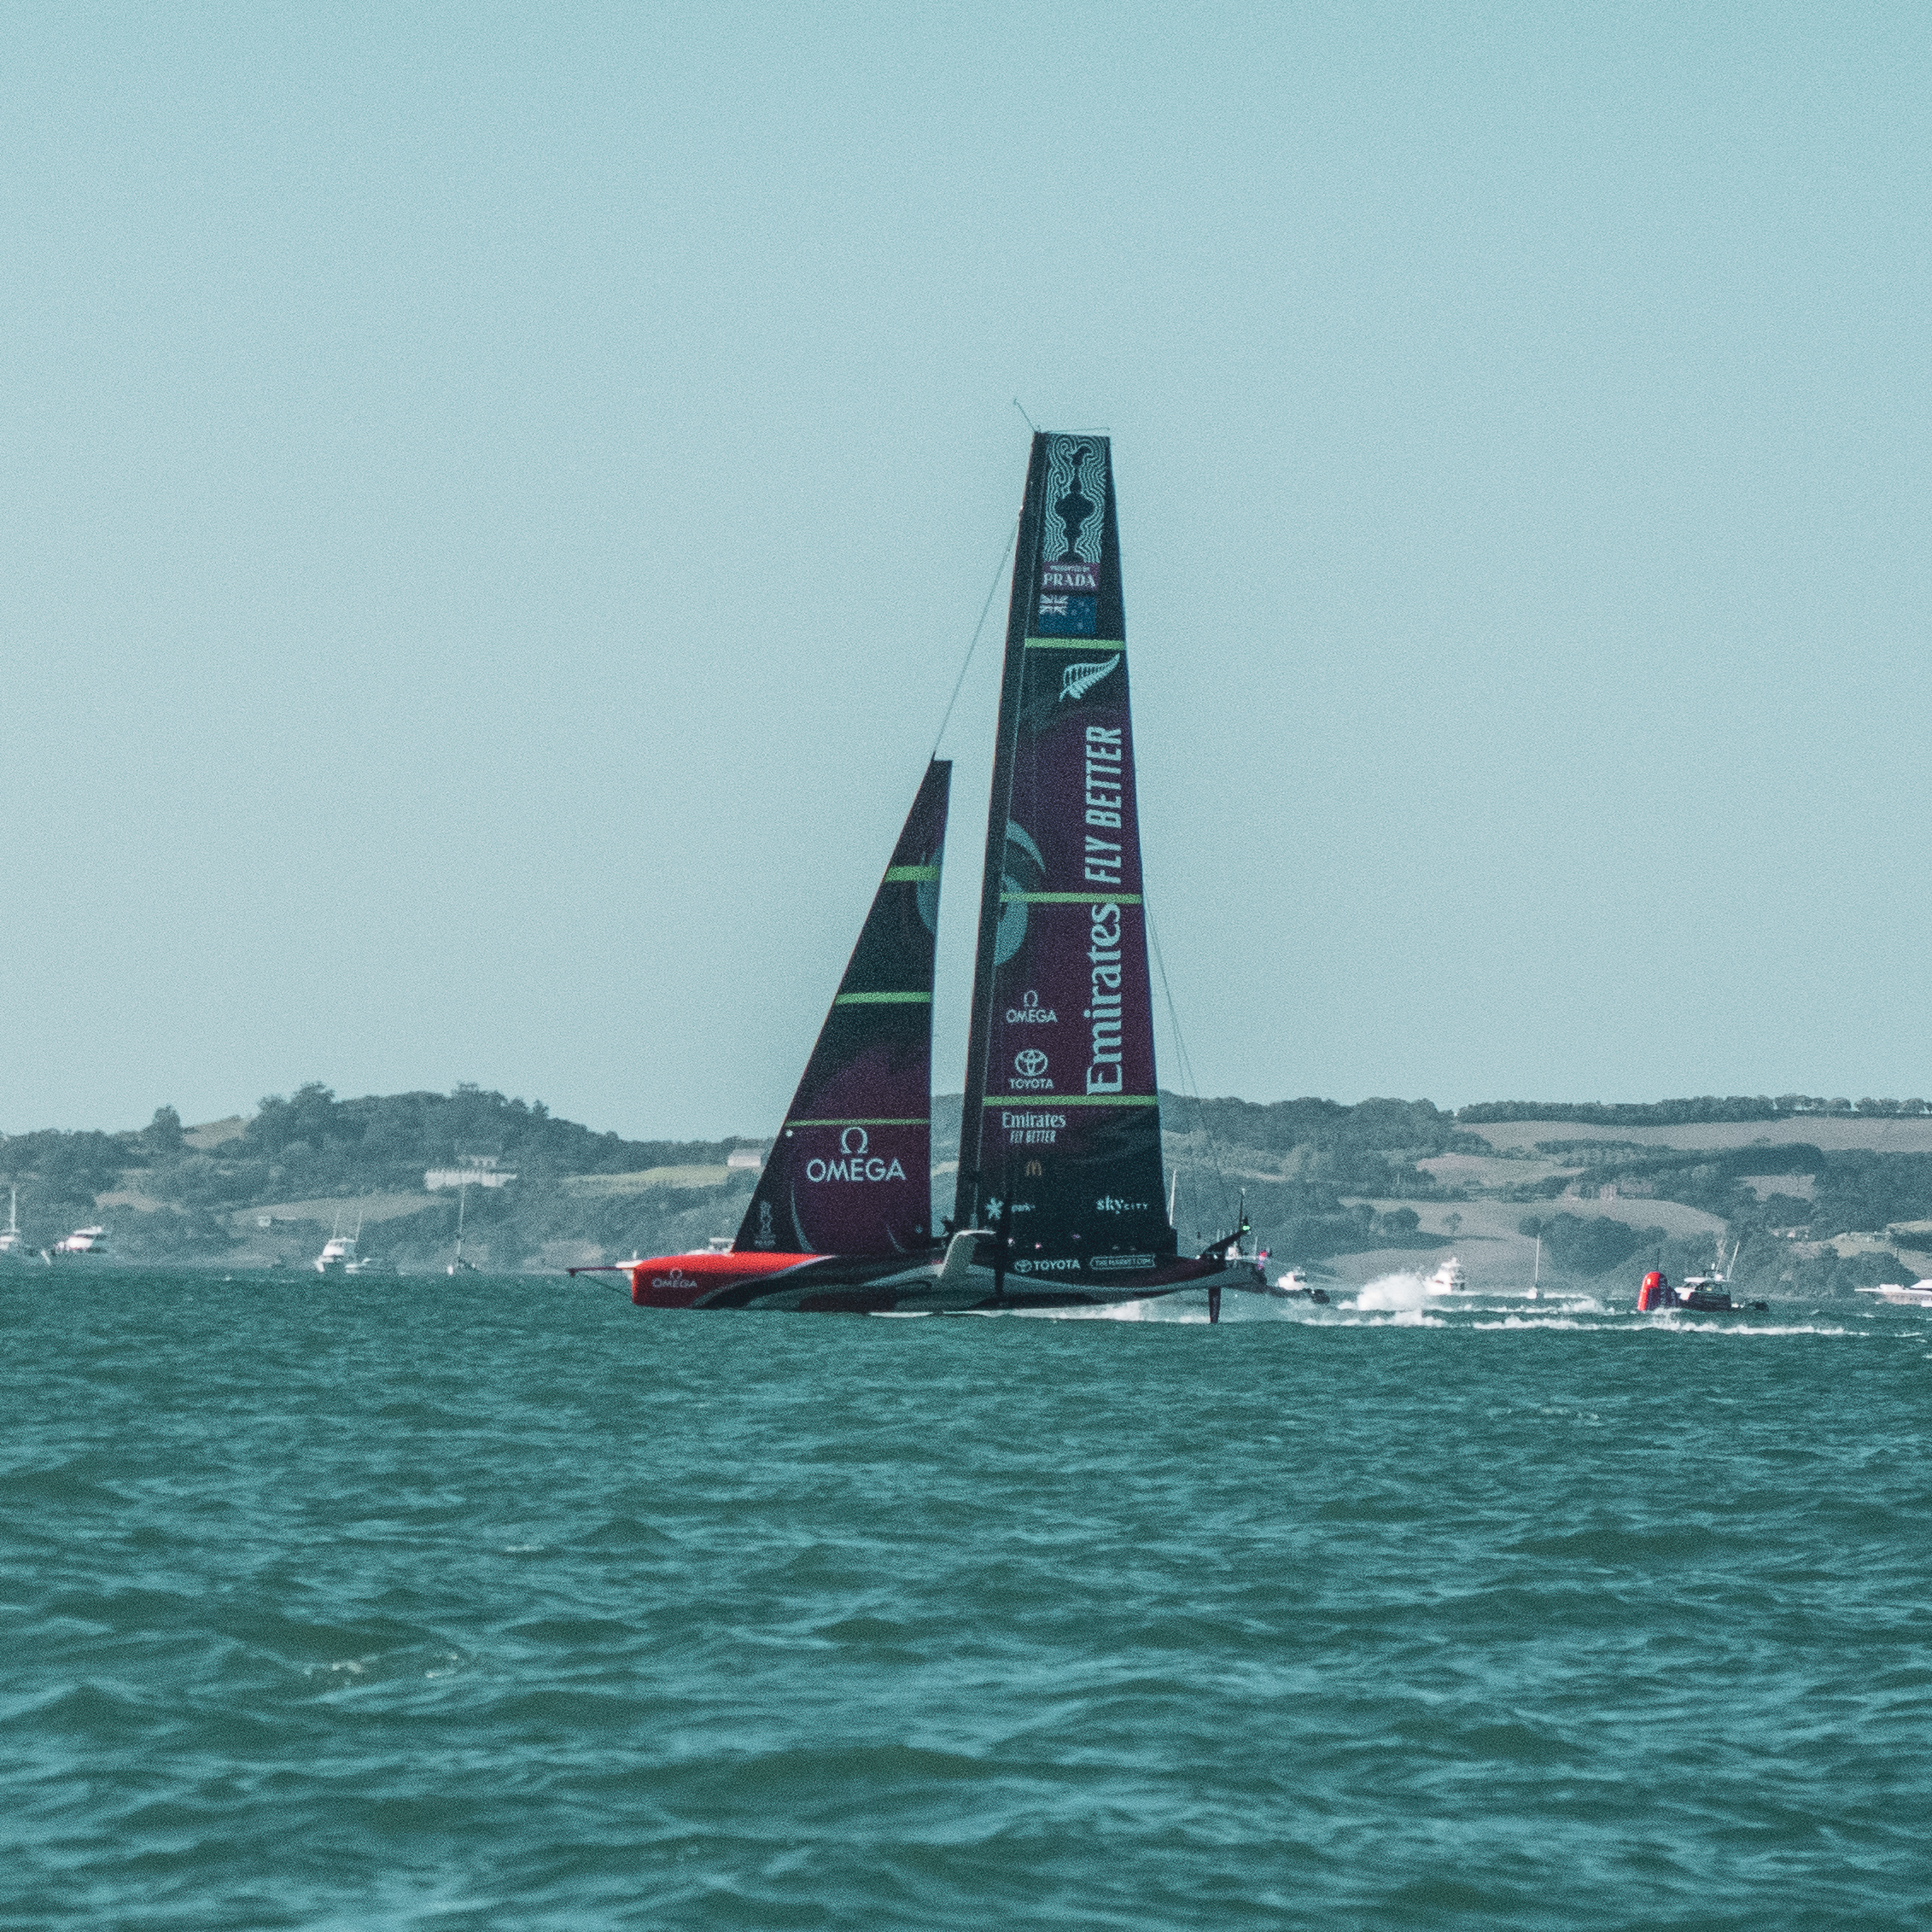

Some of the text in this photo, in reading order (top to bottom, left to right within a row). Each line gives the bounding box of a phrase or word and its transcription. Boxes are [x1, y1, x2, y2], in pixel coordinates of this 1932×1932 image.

[1042, 573, 1096, 587] PRADA
[1083, 727, 1123, 1094] Emirates FLY BETTER
[1007, 1009, 1058, 1023] OMEGA
[1008, 1078, 1054, 1089] TOYOTA
[1001, 1112, 1066, 1128] Emirates
[806, 1158, 907, 1182] OMEGA
[1033, 1259, 1081, 1271] TOYOTA
[651, 1278, 698, 1289] OMEGA
